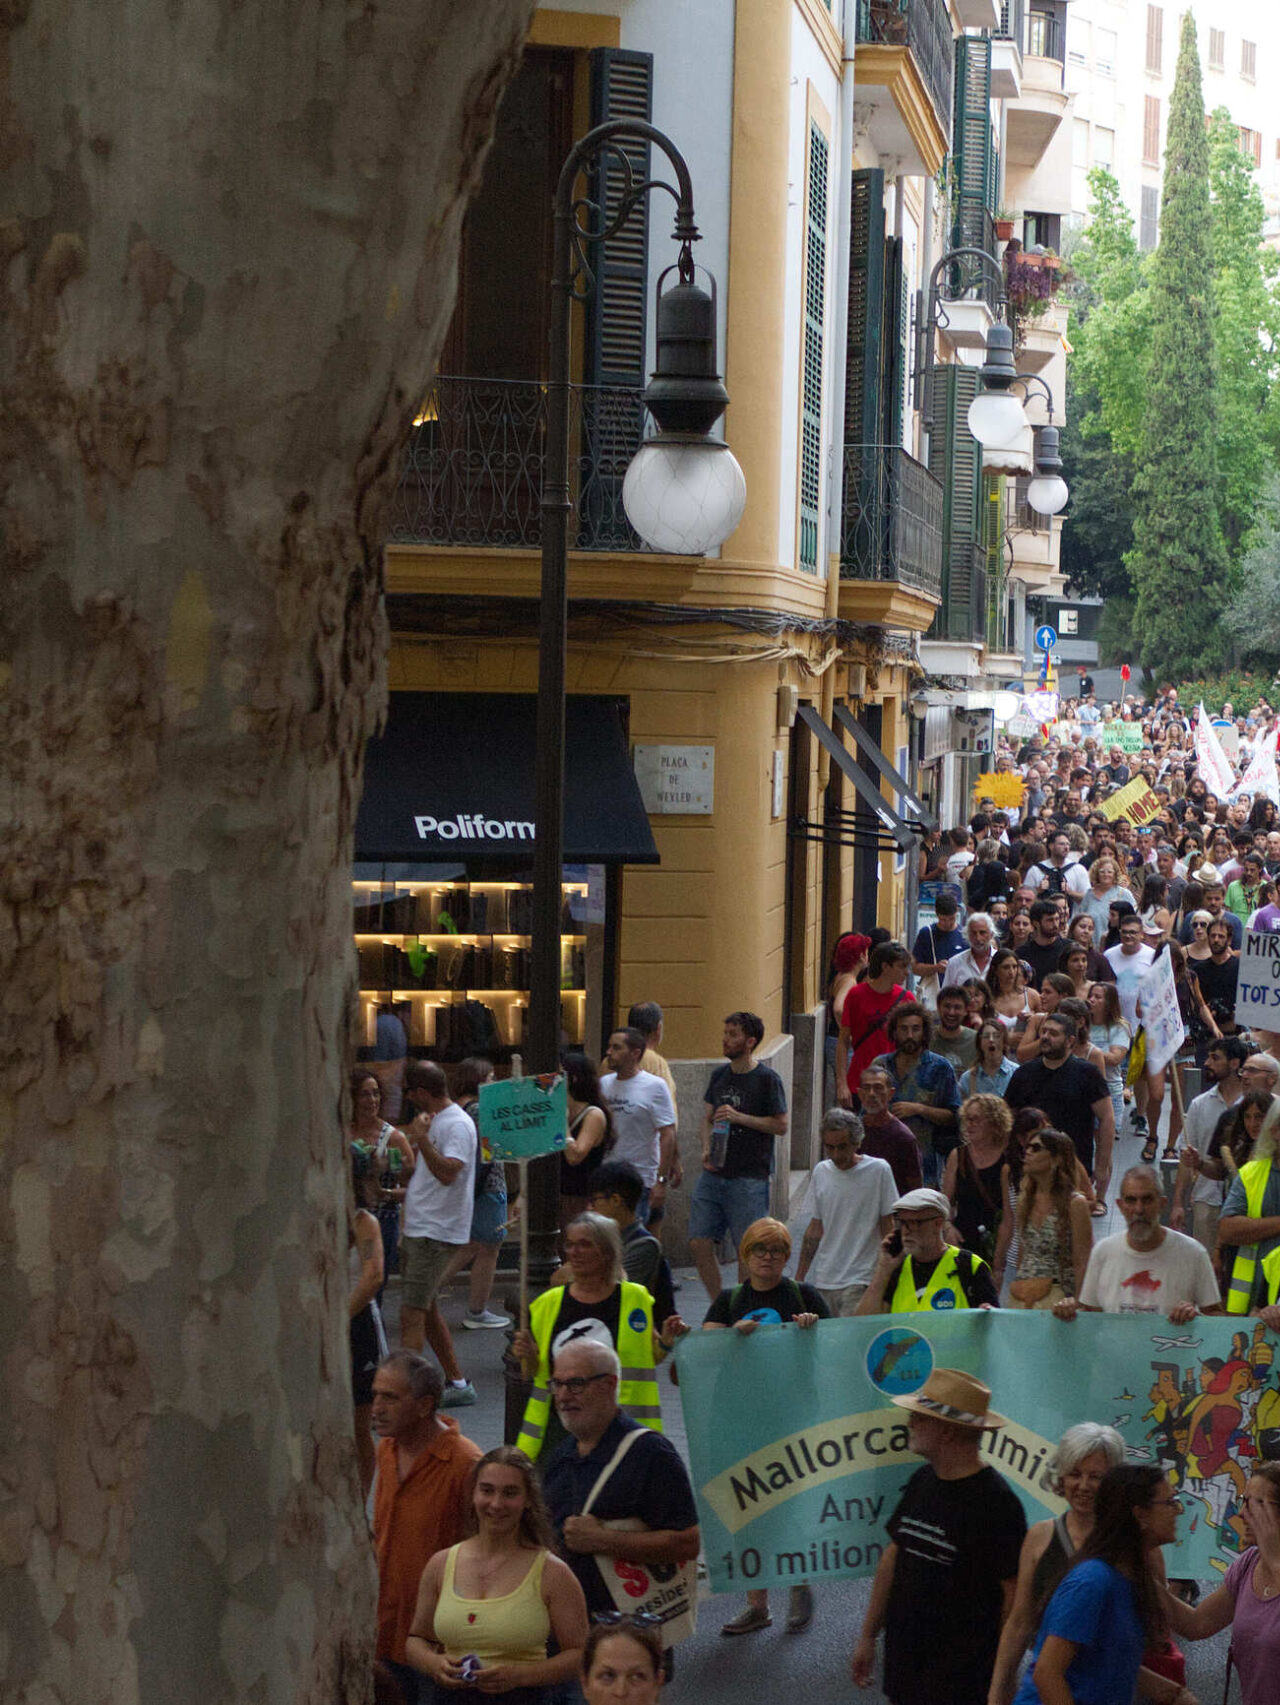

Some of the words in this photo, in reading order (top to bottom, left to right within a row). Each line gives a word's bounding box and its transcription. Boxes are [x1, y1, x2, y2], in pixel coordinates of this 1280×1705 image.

[669, 774, 678, 785] DE
[1126, 790, 1159, 825] HOME
[1240, 983, 1270, 1005] TOT
[492, 1105, 512, 1120] LES
[501, 1120, 514, 1132] AL
[937, 1300, 954, 1308] GOB
[729, 1423, 911, 1511] Mallorca
[820, 1493, 885, 1526] Any
[722, 1547, 761, 1580] 10
[775, 1541, 883, 1577] milion
